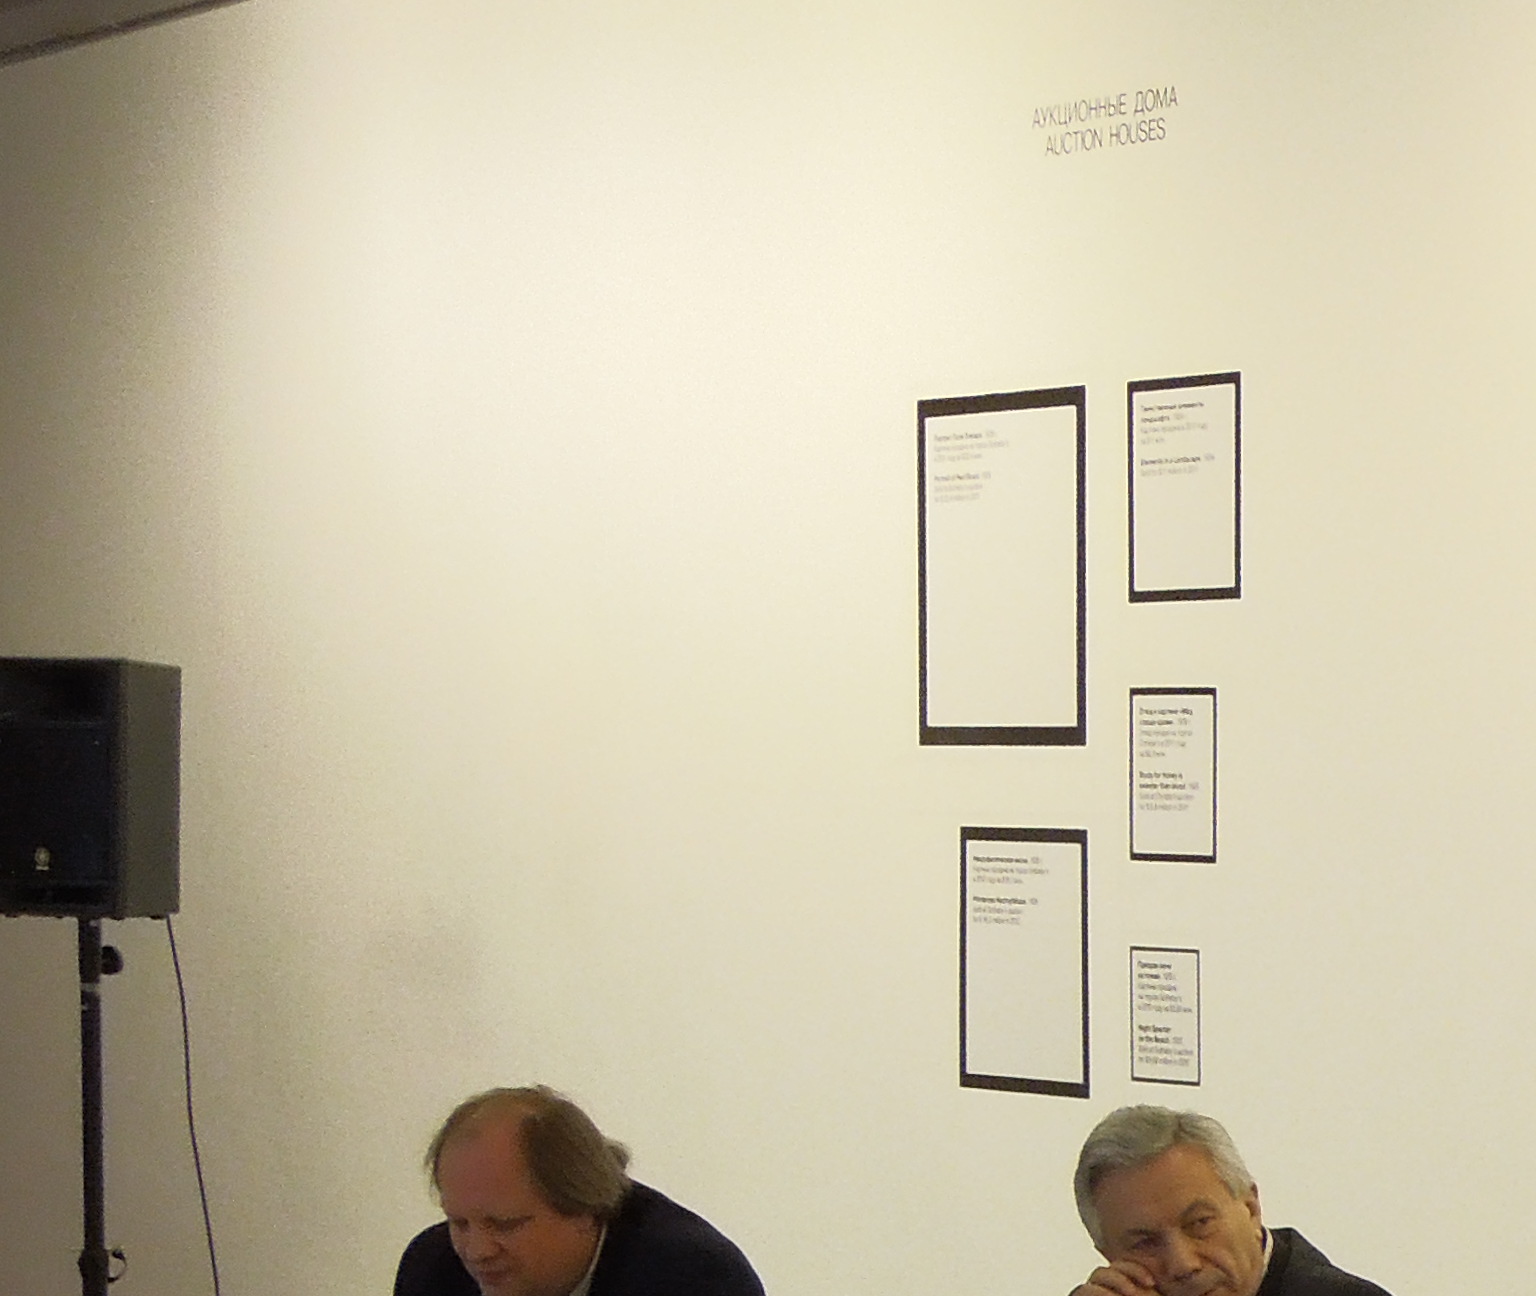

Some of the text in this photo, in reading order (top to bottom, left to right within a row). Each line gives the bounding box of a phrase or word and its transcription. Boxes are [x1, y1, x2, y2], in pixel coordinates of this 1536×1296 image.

[1032, 84, 1178, 127] АУКЦИОННЫЕ ДОМА
[1045, 116, 1166, 156] AUCTION HOUSES
